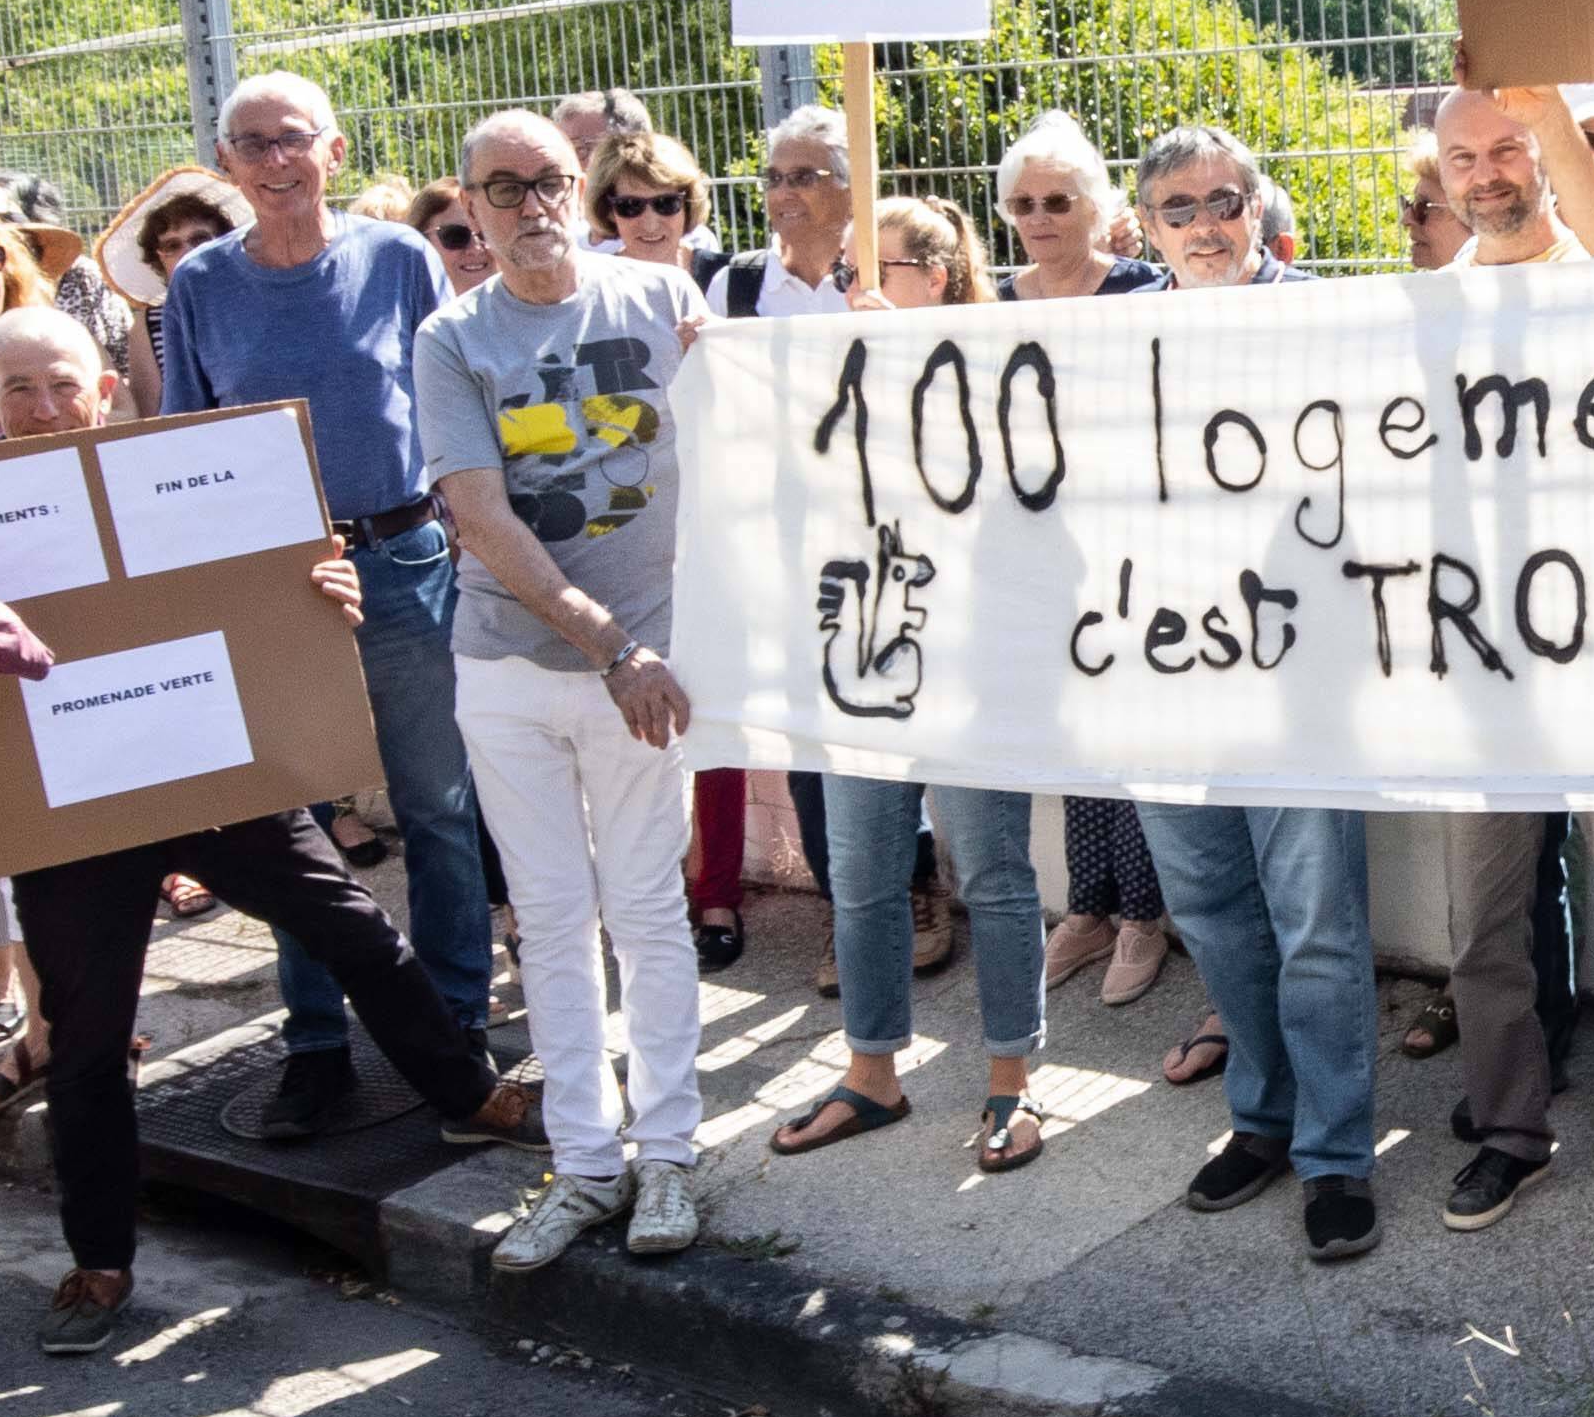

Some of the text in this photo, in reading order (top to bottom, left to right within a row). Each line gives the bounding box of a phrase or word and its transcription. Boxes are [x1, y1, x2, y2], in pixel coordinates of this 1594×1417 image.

[813, 337, 1068, 526] 100
[156, 471, 234, 494] FIN DE LA
[1070, 558, 1297, 677] c'est
[52, 671, 214, 715] PROMENADE VERTE
